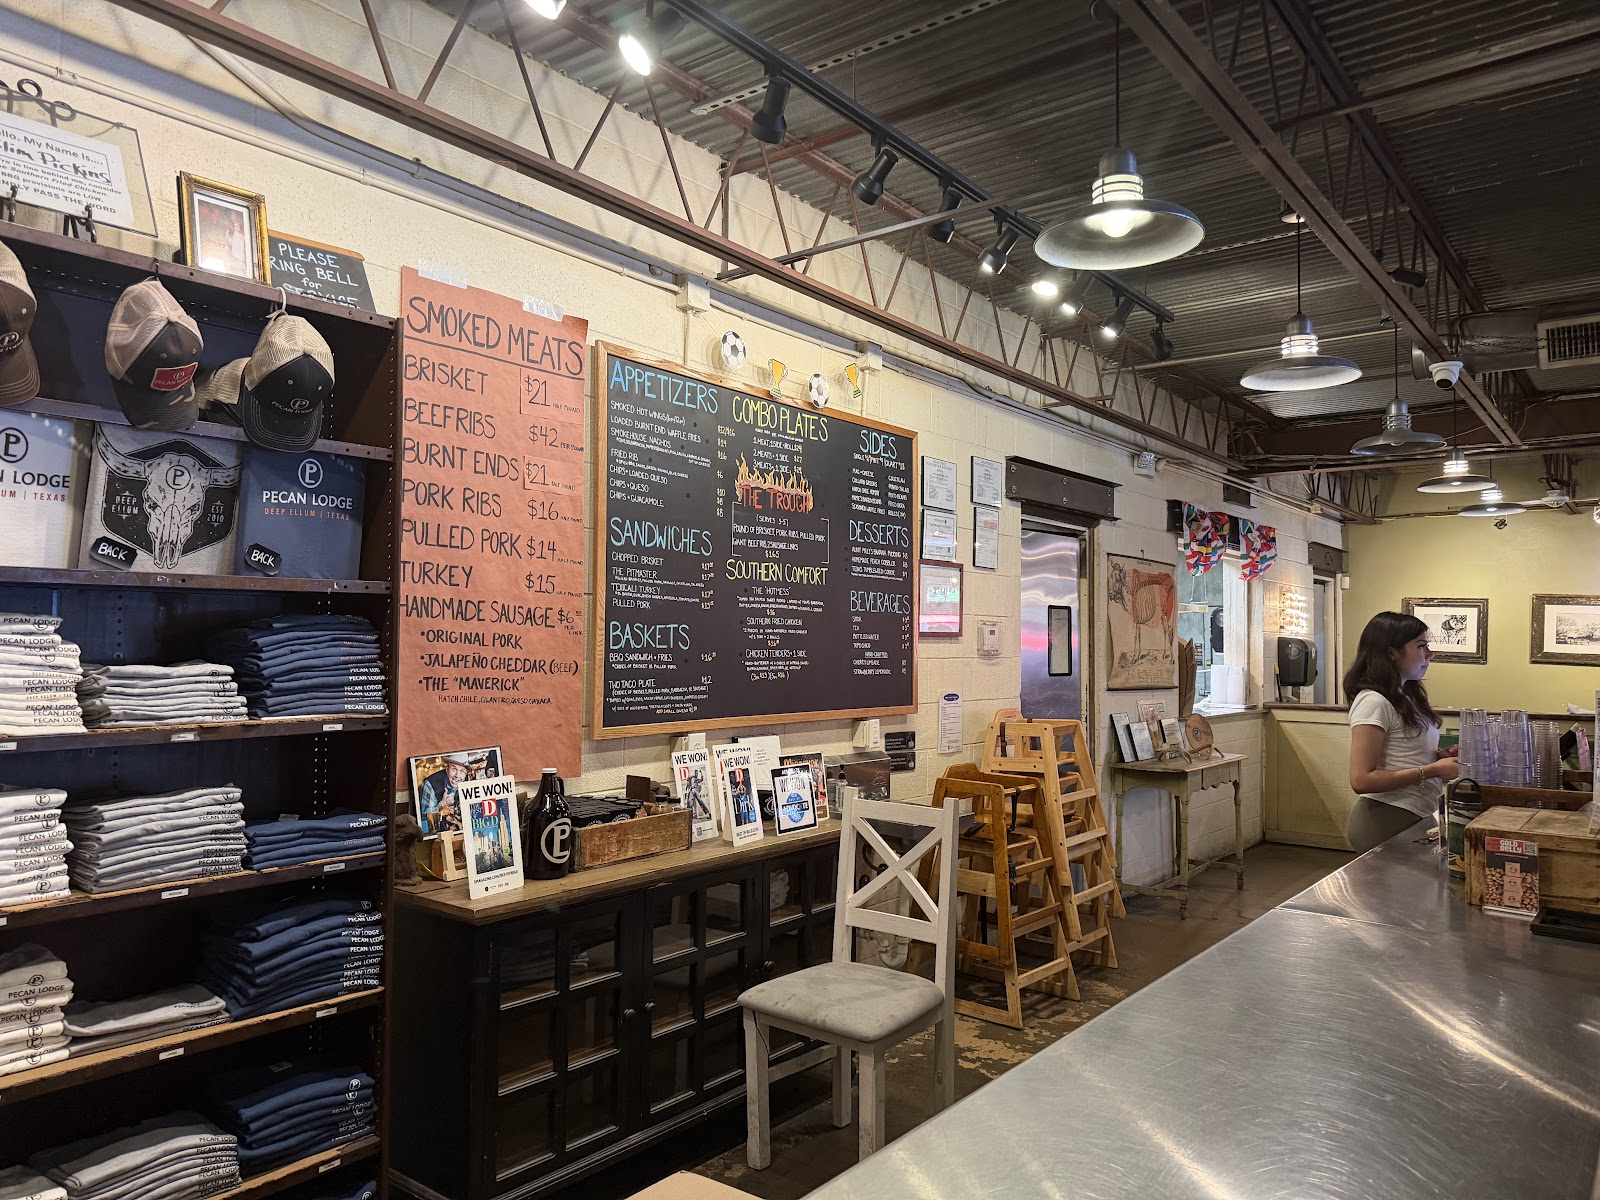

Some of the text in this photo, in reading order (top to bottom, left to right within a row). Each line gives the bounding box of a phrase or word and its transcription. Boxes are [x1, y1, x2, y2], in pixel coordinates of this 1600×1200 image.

[0, 129, 79, 158] llo. My Name
[0, 141, 34, 160] lim
[37, 151, 112, 185] Pickins
[11, 166, 49, 181] Southern
[52, 176, 72, 188] Fried
[22, 178, 66, 192] provisions
[41, 168, 69, 180] behind
[88, 183, 122, 195] consider
[34, 188, 116, 214] PASS THE WORD
[278, 243, 340, 268] PLEASE
[269, 256, 358, 286] RING BELL
[302, 278, 322, 290] for
[406, 296, 584, 376] SMOKED MEATS
[404, 354, 550, 406] BRISKET $21
[610, 360, 718, 414] APPETIZERS
[610, 400, 648, 416] SMOKED HOT
[732, 396, 778, 428] COMBO
[780, 407, 828, 442] PLATES
[528, 423, 558, 448] $42
[610, 415, 633, 427] LOADED
[634, 420, 654, 432] BURNT
[654, 424, 666, 434] END
[666, 429, 687, 440] WAFFLE
[688, 432, 702, 443] FRIES
[610, 427, 672, 448] SMOKEHOUSE NACHOS
[610, 448, 628, 459] FRIED
[860, 430, 897, 460] SIDES
[402, 437, 550, 486] BURNT ENDS $21
[13, 470, 70, 488] LODGE
[610, 464, 626, 476] CHIPS
[628, 470, 650, 480] LOADED
[650, 474, 668, 484] QUESO
[610, 478, 650, 492] CHIPS QUESO
[34, 492, 66, 502] TEXAS
[116, 496, 137, 504] DEEP
[262, 490, 352, 510] PECAN LODGE
[402, 479, 559, 520] PORK RIBS $16
[610, 490, 664, 508] CHIPS GUACAMOLE
[739, 484, 814, 514] THE TROUGH
[207, 514, 224, 523] 2010
[264, 508, 350, 521] DEEP ELLUM TEXAS
[400, 519, 556, 562] PULLED PORK $14
[610, 516, 713, 556] SANDWICHES
[800, 532, 814, 540] PULLED
[850, 520, 909, 548] DESSERTS
[98, 542, 128, 561] BACK
[250, 550, 275, 567] BACK
[612, 552, 664, 566] CHOPPED BRISKET
[400, 560, 556, 594] TURKEY $15
[612, 566, 658, 580] THE PITMASTER
[726, 559, 782, 582] SOUTHERN
[785, 564, 828, 586] COMFORT
[638, 586, 661, 594] TURKEY
[752, 586, 763, 595] THE
[612, 598, 651, 610] PULLED PORK
[850, 590, 910, 614] BEVERAGES
[34, 618, 60, 626] LODGE
[490, 601, 555, 628] SAUSAGE
[747, 617, 771, 626] SOUTHERN
[785, 618, 802, 626] CHICKEN
[492, 632, 523, 650] PORK
[610, 621, 690, 650] BASKETS
[610, 652, 673, 662] BBQ SANDWICH FRIES
[746, 649, 768, 658] CHICKEN
[424, 652, 578, 676] JALAPEÑO CHEDDAR (BEEF)
[423, 676, 524, 692] THE "MAVERICK"
[609, 678, 656, 690] TWO TACO PLATE
[438, 695, 458, 703] HATCH
[674, 752, 708, 765] WE WON!
[724, 758, 734, 768] WE
[680, 767, 689, 780] D
[736, 768, 744, 782] D
[461, 782, 513, 800] WE WON!
[483, 800, 497, 816] D
[472, 816, 499, 830] BIG D
[15, 846, 41, 854] PECAN
[8, 985, 65, 998] PECAN LODGE
